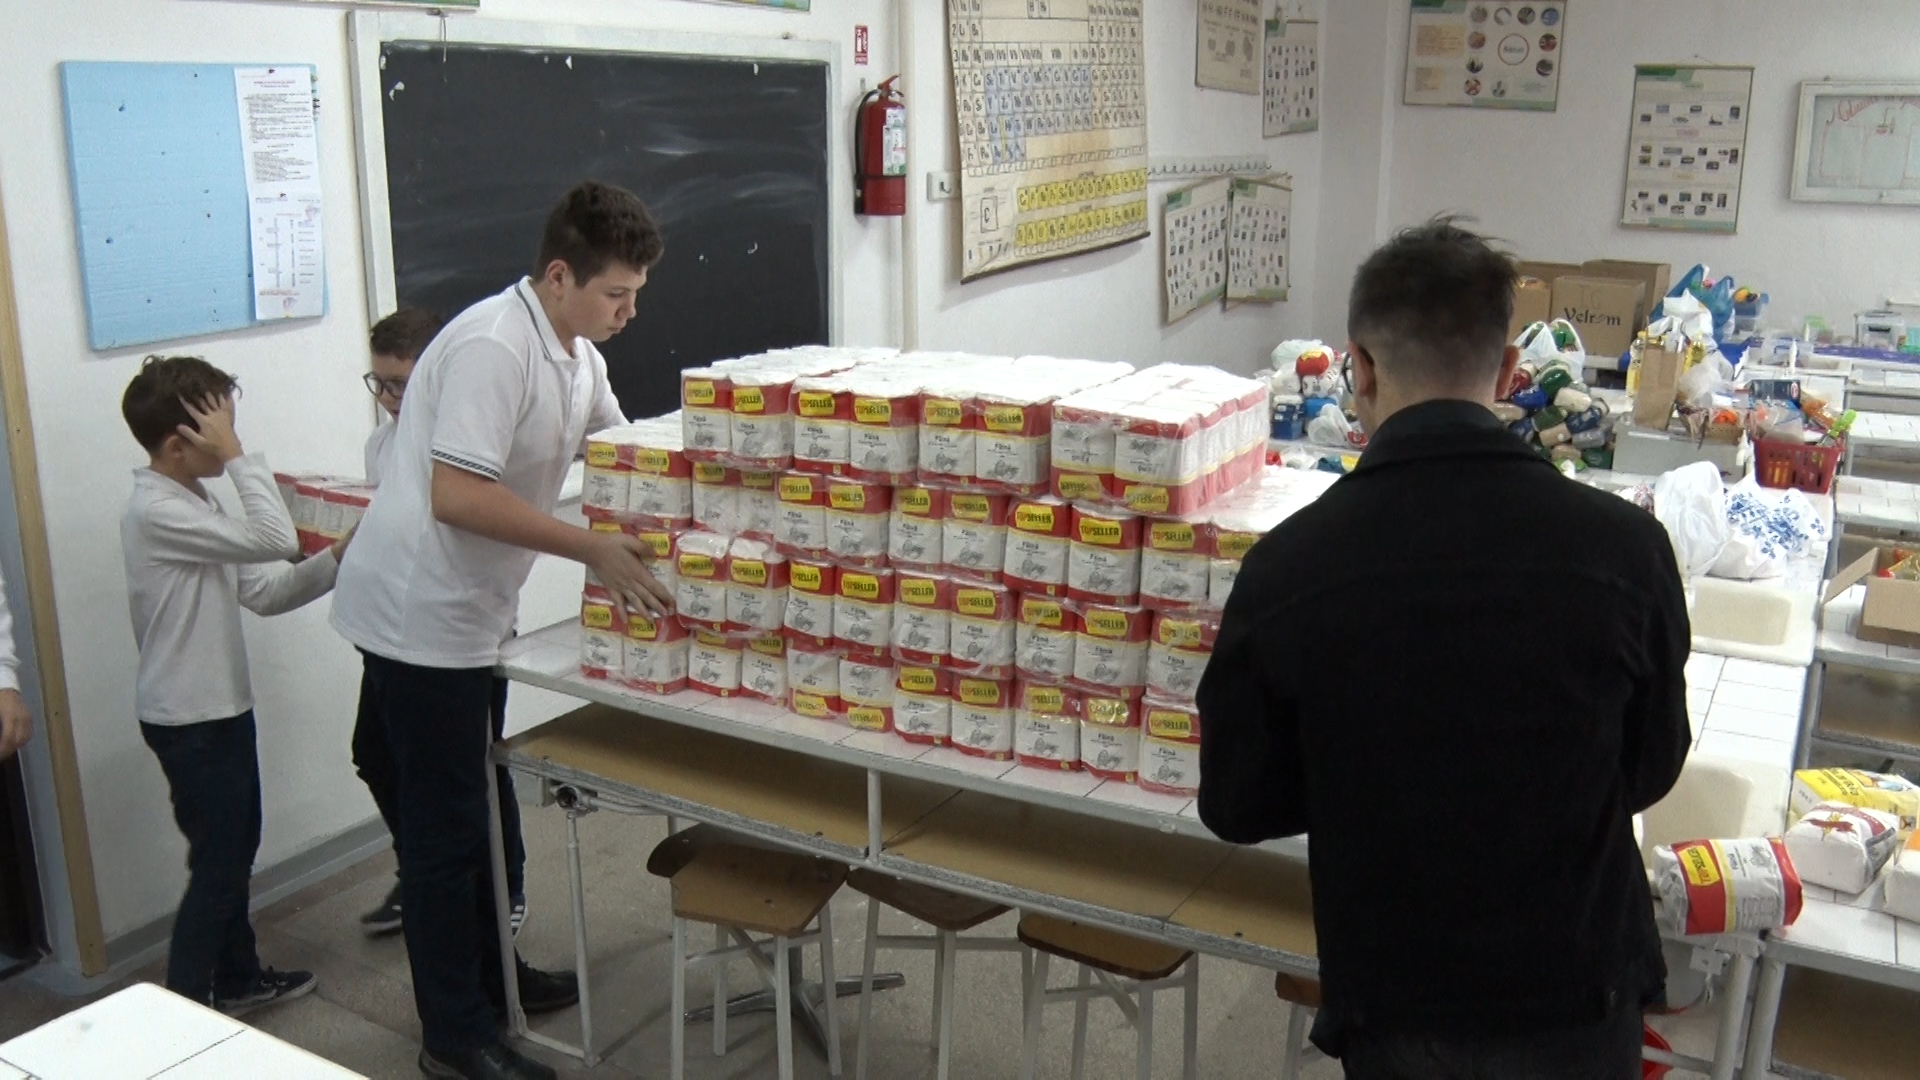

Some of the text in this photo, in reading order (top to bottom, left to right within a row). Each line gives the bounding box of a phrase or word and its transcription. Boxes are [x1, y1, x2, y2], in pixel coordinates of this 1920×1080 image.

[800, 398, 834, 410] TOPSELLER
[855, 404, 890, 415] TOPSELLER
[1080, 524, 1120, 537] TOPSELLER
[843, 580, 877, 592] TOPSELLER
[902, 586, 935, 597] TOPSELLER
[958, 596, 994, 607] TOPSELLER
[1150, 719, 1189, 730] TOPSELLER
